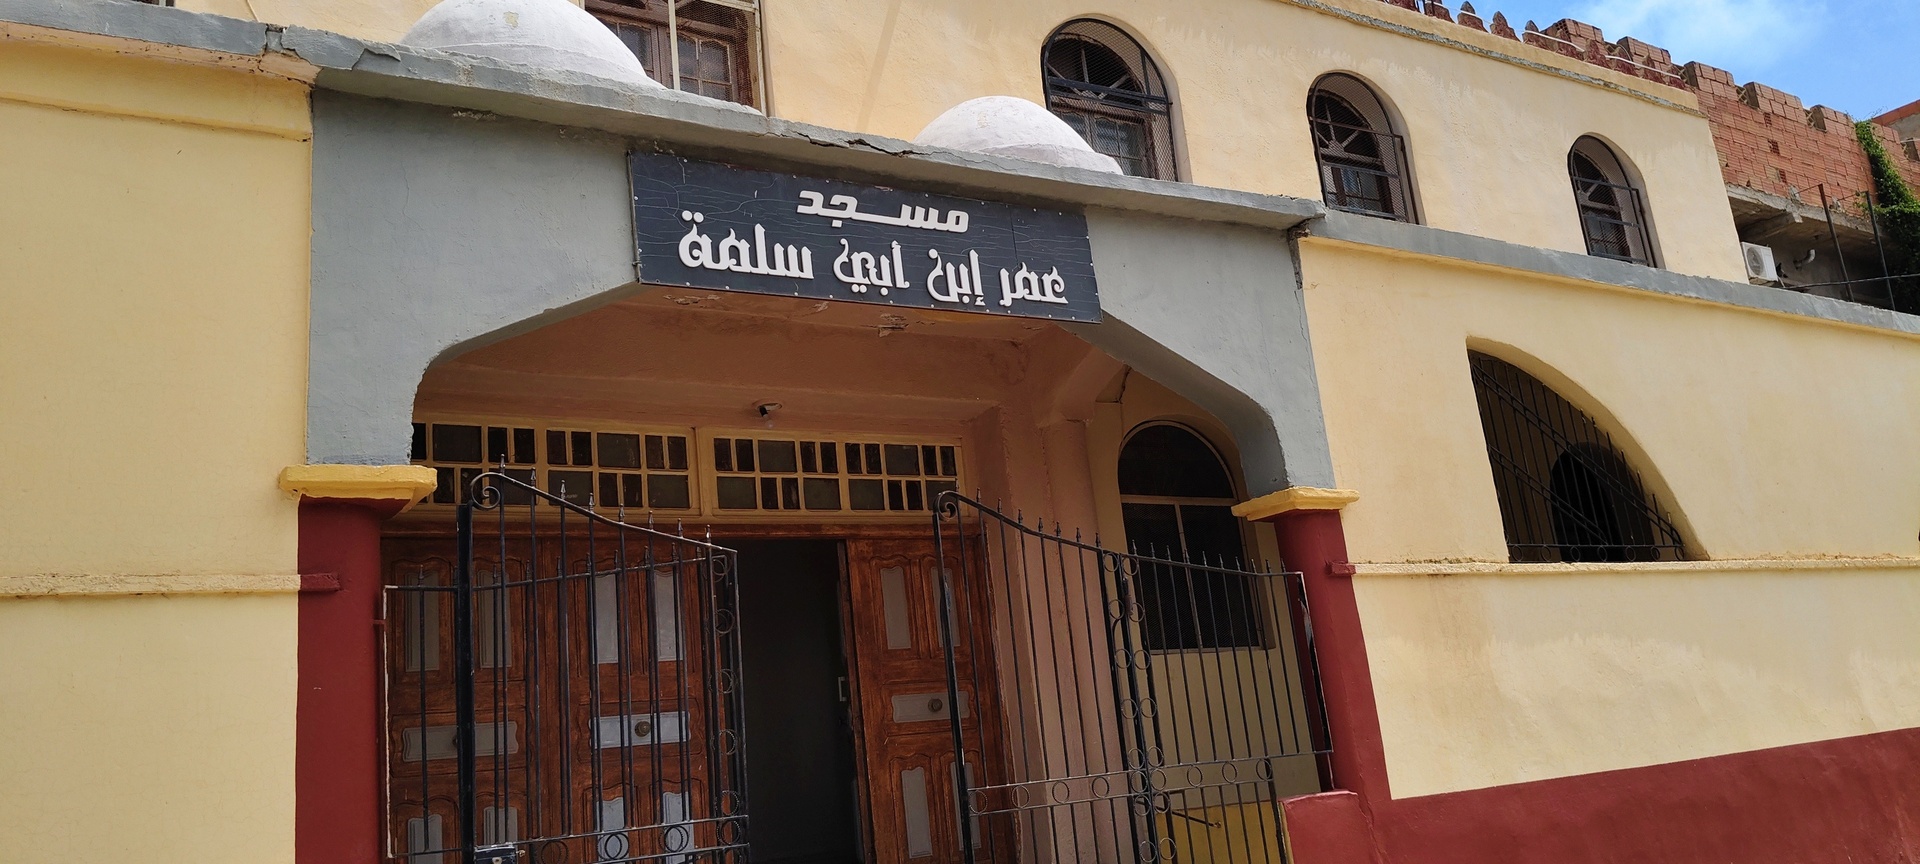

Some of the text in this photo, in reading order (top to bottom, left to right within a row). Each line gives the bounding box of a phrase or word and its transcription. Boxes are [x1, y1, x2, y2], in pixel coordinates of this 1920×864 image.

[796, 190, 970, 233] مسجد
[677, 210, 1069, 307] عمر إبن أبي سلمة
